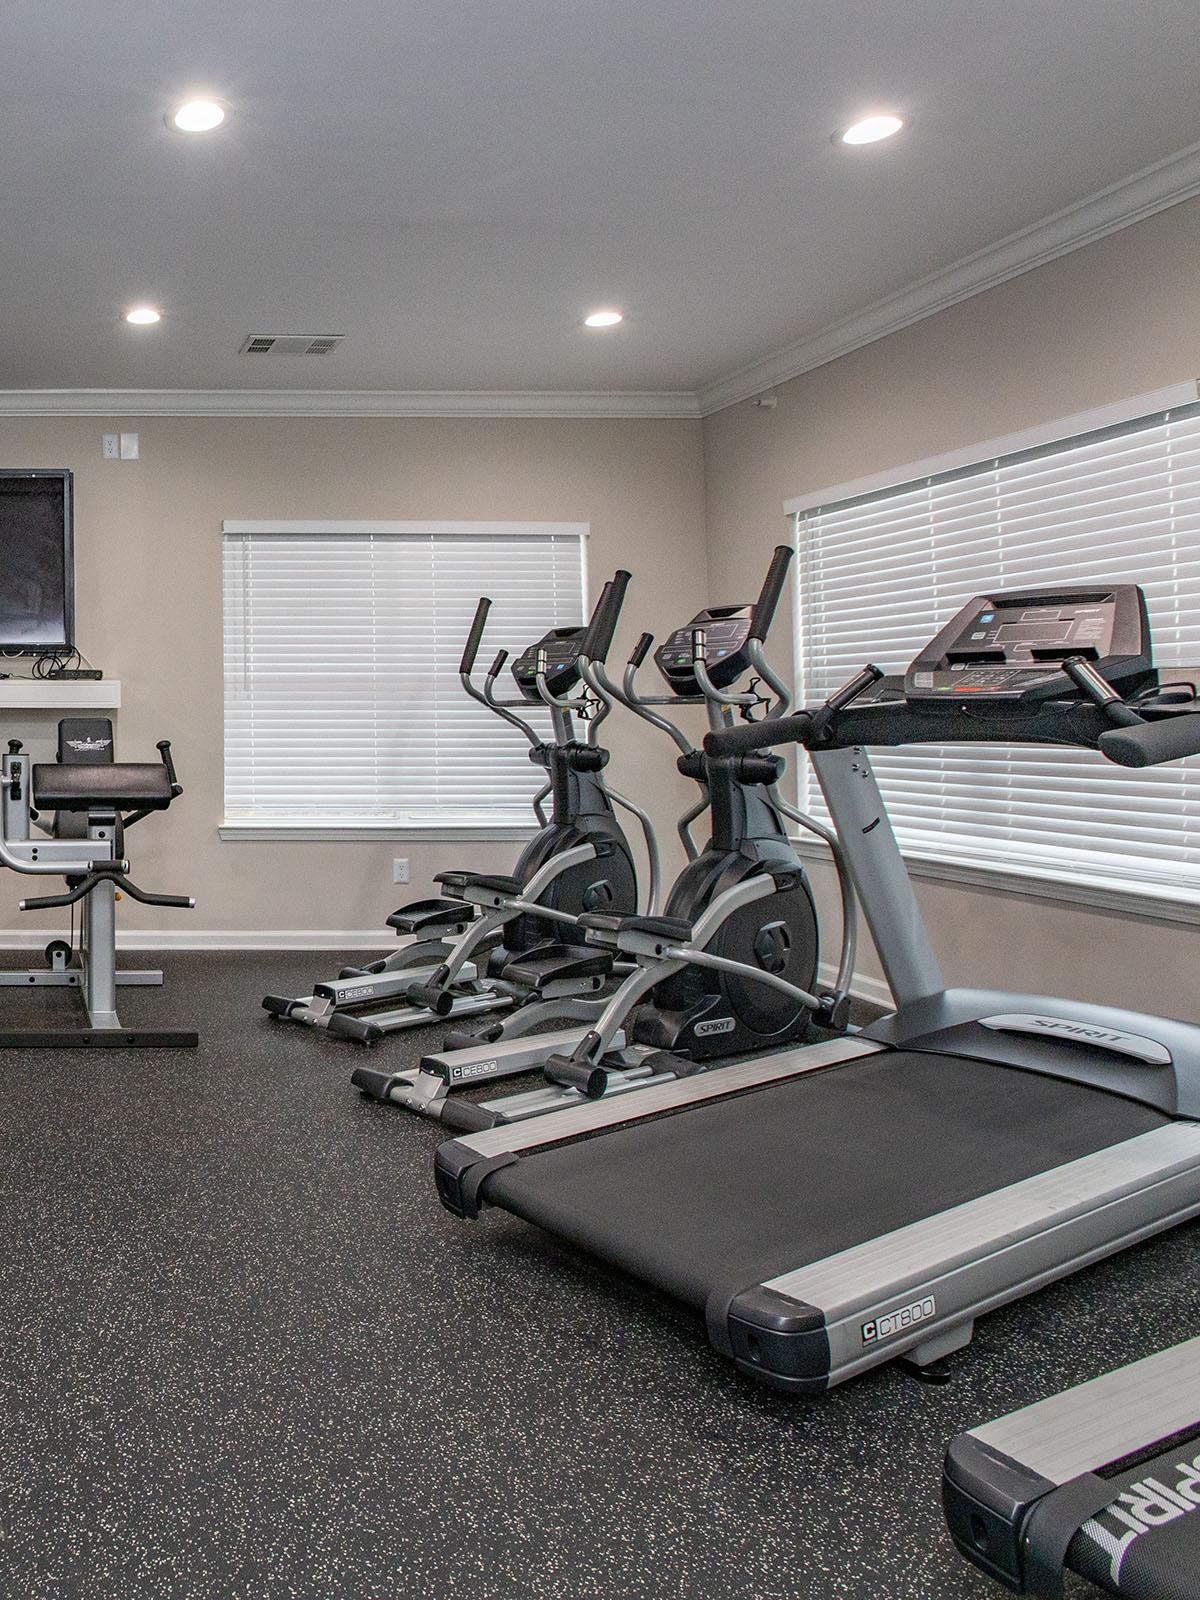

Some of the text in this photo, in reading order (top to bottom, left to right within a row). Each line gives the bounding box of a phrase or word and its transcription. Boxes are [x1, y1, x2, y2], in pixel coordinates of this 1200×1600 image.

[699, 1021, 731, 1034] SPIRIT
[1029, 1019, 1132, 1042] SPIRIT
[880, 1299, 933, 1336] CT800
